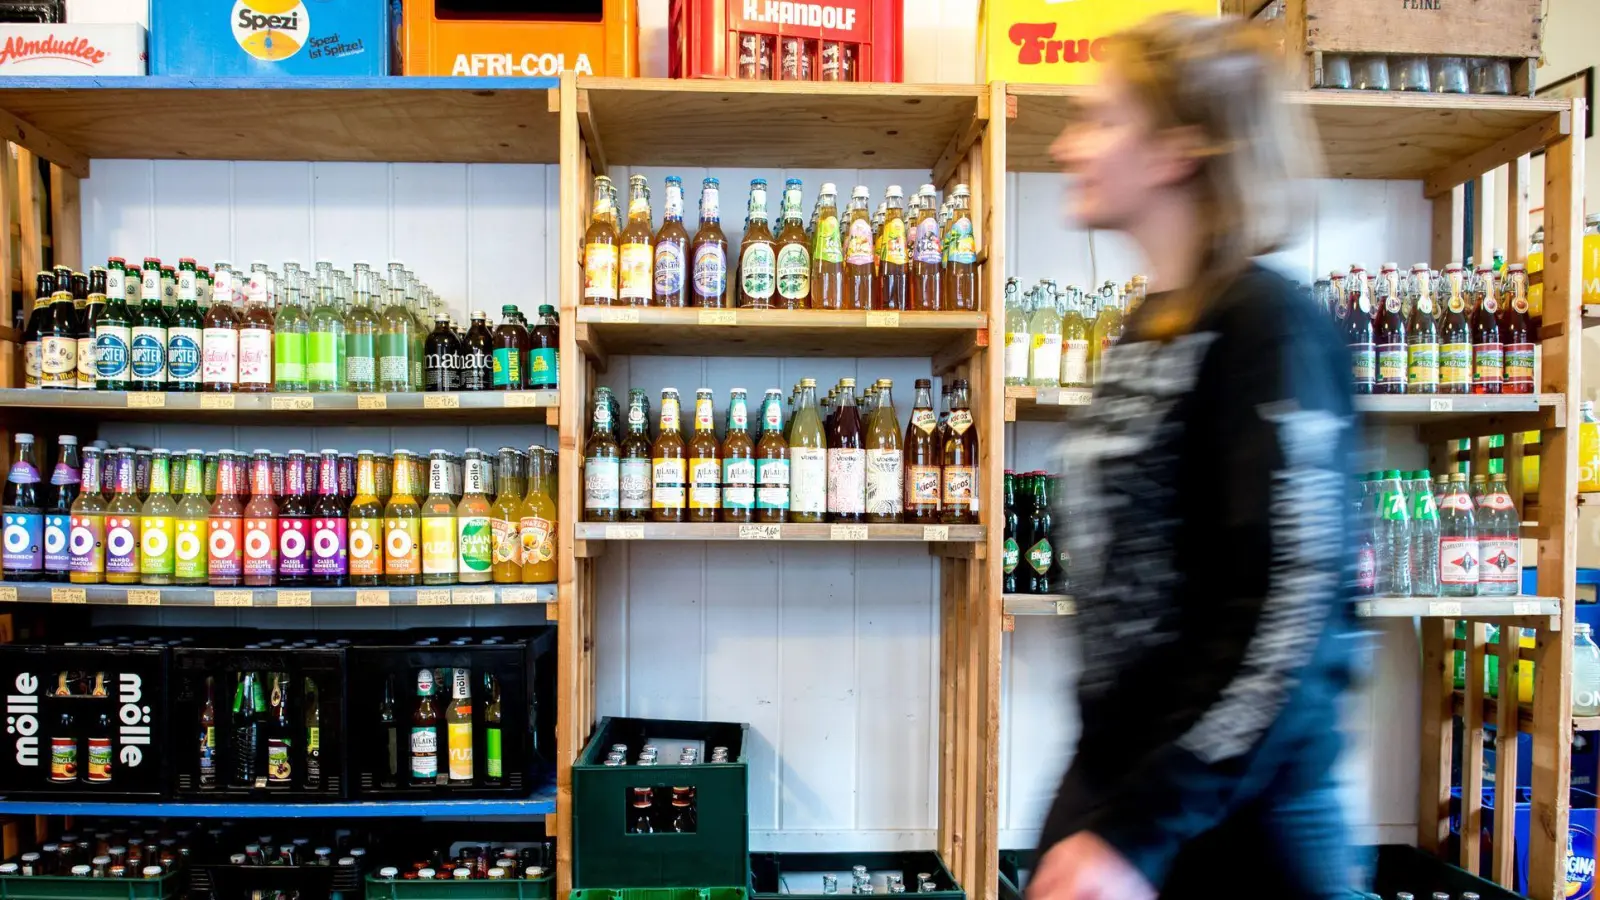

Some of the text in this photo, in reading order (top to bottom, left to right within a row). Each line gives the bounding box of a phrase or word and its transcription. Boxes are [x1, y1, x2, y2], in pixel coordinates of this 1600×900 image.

[239, 9, 298, 31] Spezi
[309, 33, 339, 48] Spezi
[323, 38, 364, 56] Spitze!
[452, 53, 593, 77] AFRI-COLA
[432, 463, 441, 490] mölle
[470, 463, 479, 490] mölle
[7, 672, 39, 766] mölle
[119, 673, 151, 767] mölle
